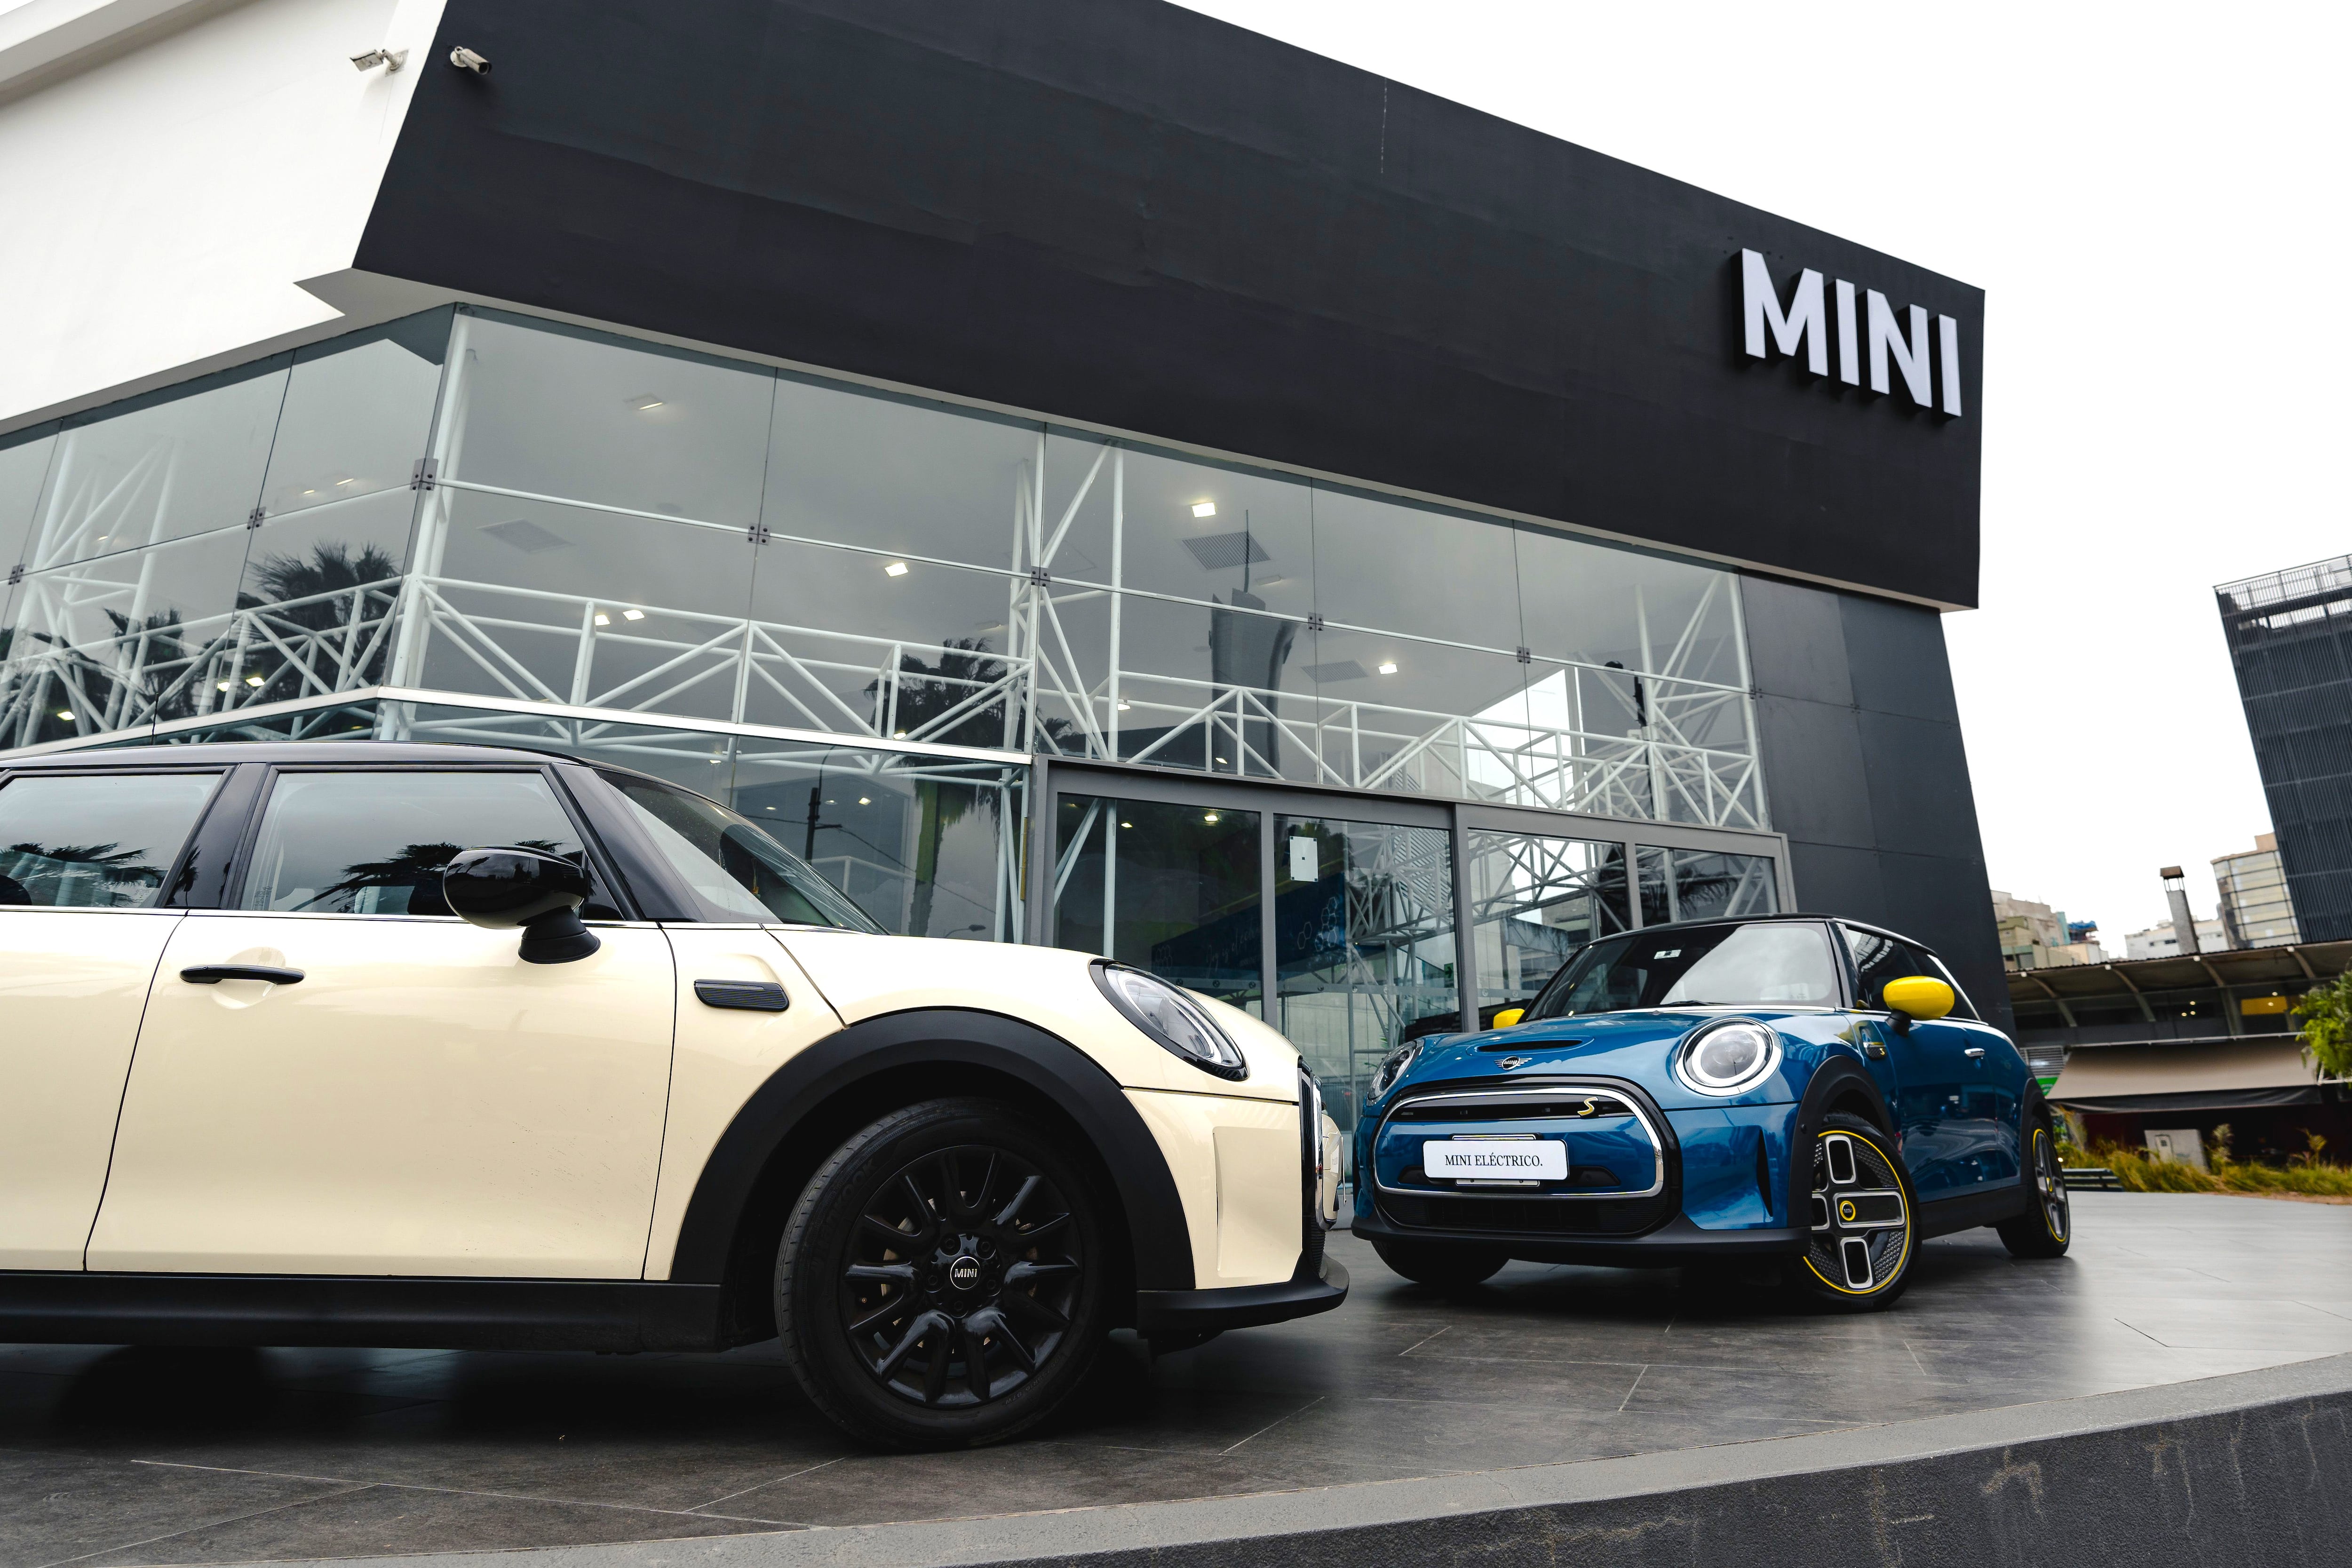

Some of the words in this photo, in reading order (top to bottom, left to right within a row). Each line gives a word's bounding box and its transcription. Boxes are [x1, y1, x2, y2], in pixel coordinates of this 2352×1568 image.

[1742, 248, 1962, 417] MINI
[1577, 1096, 1599, 1116] S
[1445, 1154, 1472, 1166] MINI
[1475, 1152, 1543, 1167] ELÉCTRICO.
[954, 1268, 977, 1277] MINI
